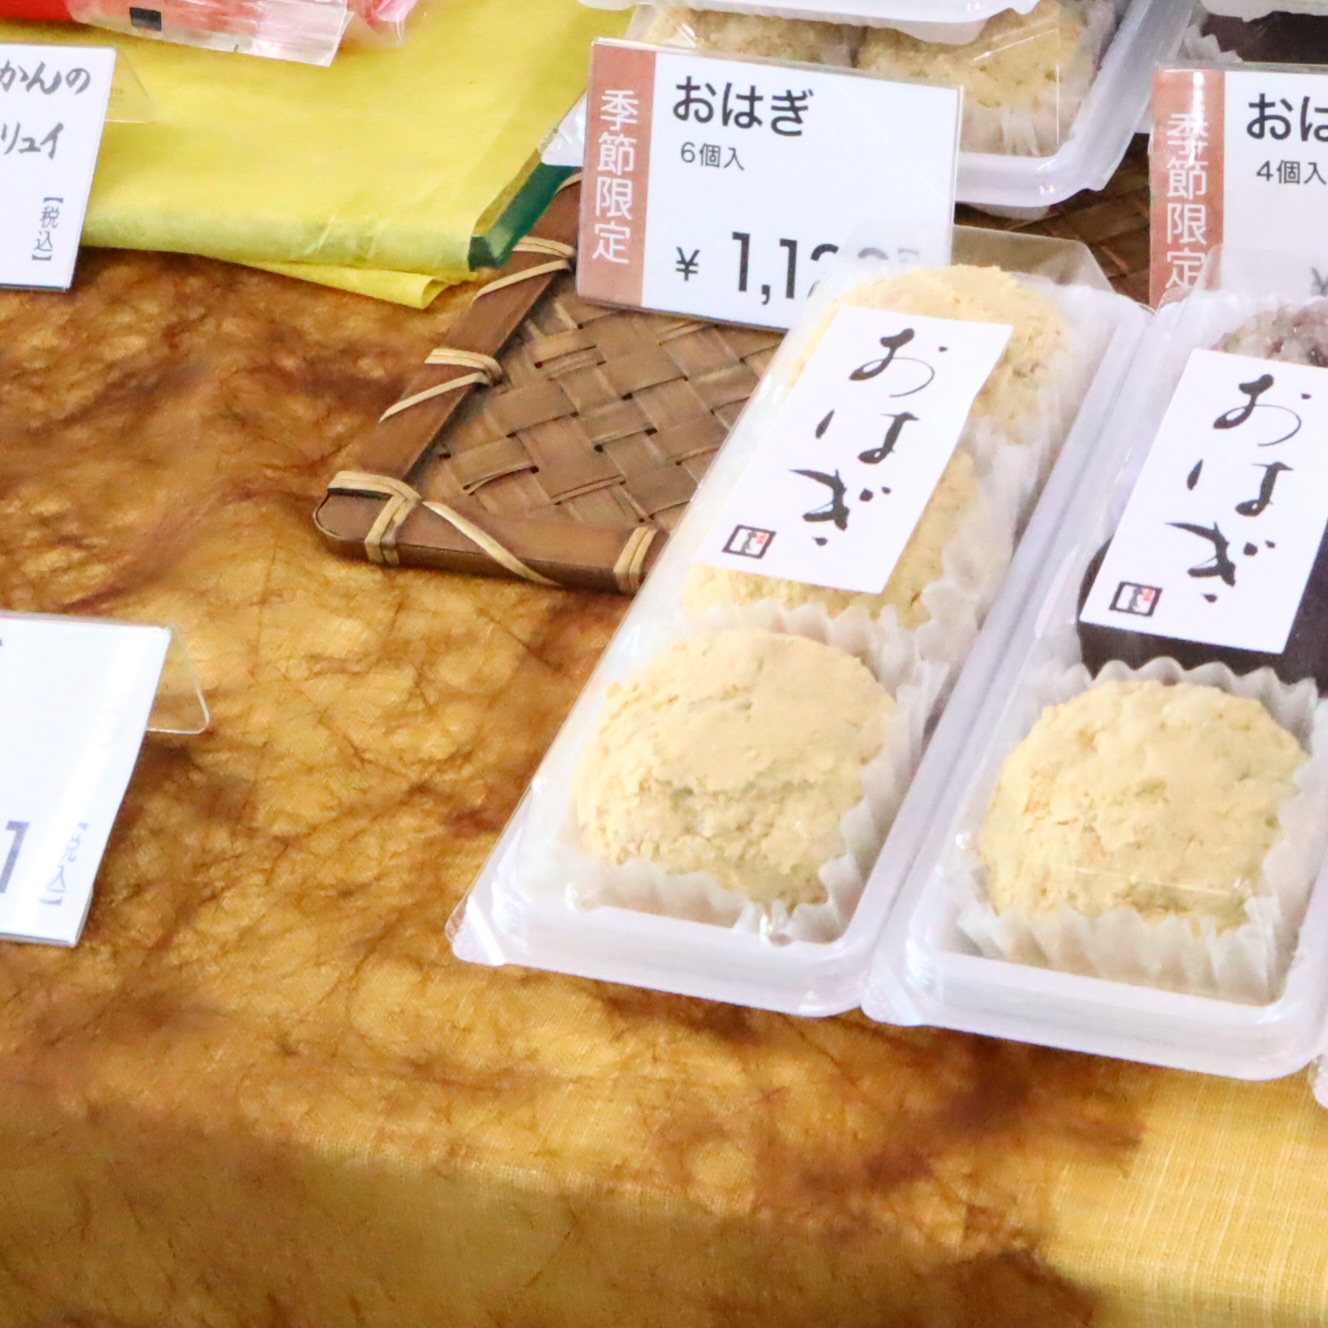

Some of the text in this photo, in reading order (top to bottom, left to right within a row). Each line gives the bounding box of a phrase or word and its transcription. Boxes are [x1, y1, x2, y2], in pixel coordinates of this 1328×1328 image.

[672, 76, 814, 138] おはぎ
[680, 141, 745, 171] 6個入
[592, 88, 640, 265] 季節限定
[1165, 112, 1208, 290] 季節限定
[1255, 159, 1328, 186] 4個入
[731, 231, 889, 306] 1,1
[787, 327, 949, 546] おはぎ
[1165, 373, 1312, 603] おはぎ
